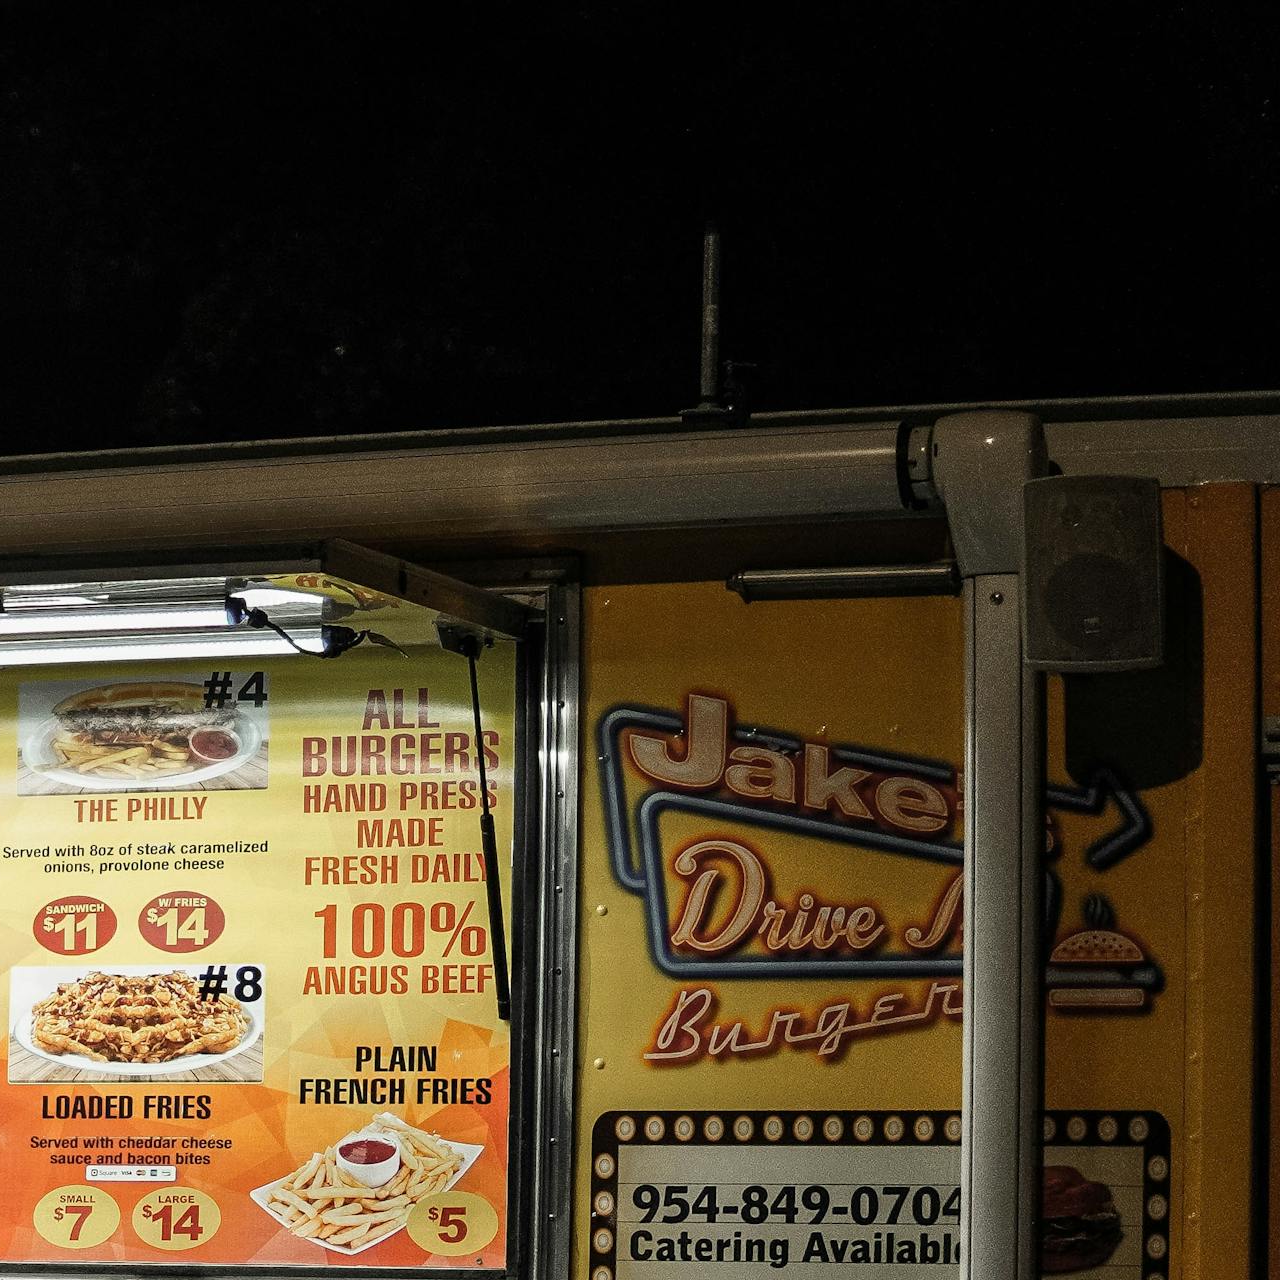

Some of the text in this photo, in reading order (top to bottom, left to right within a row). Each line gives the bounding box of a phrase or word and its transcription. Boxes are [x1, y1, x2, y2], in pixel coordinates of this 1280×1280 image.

[204, 671, 268, 708] #4
[362, 688, 440, 730] ALL
[302, 730, 500, 778] BURGERS
[75, 797, 208, 823] THE PHILLY
[304, 780, 498, 814] HAND PRESS
[356, 817, 444, 848] MADE
[304, 852, 490, 886] FRESH DAILY
[671, 839, 886, 954] Drive
[43, 913, 100, 949] $11
[147, 907, 209, 946] $14
[314, 900, 487, 958] 100%
[198, 965, 263, 1002] #8
[302, 963, 494, 996] ANGUS BEEF
[643, 982, 964, 1067] Burger
[355, 1045, 438, 1073] PLAIN
[42, 1095, 211, 1120] LOADED FRIES
[299, 1078, 492, 1106] FRENCH FRIES
[60, 1195, 96, 1205] SMALL
[158, 1194, 195, 1205] LARGE
[631, 1183, 961, 1226] 954-849-0704
[53, 1205, 93, 1241] $7
[142, 1204, 203, 1241] $14
[428, 1205, 468, 1244] $5
[629, 1229, 791, 1268] Catering
